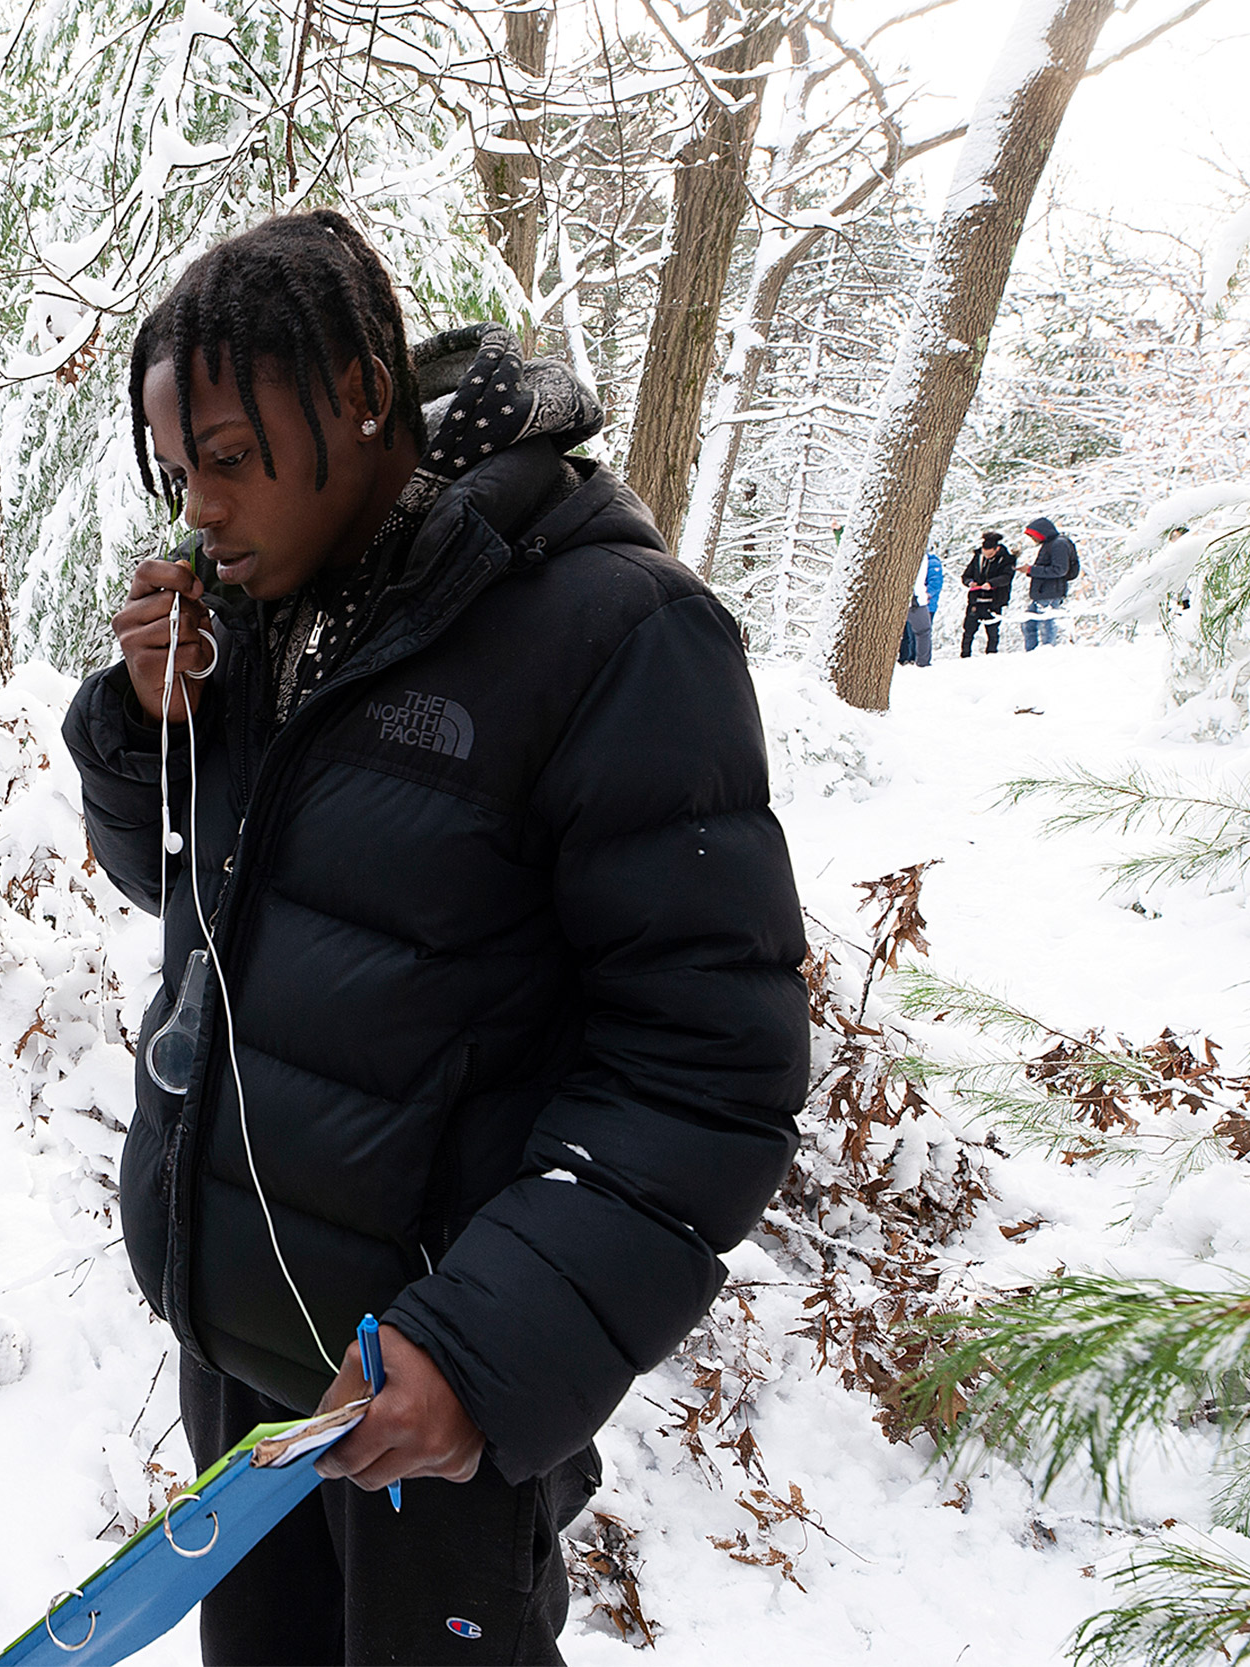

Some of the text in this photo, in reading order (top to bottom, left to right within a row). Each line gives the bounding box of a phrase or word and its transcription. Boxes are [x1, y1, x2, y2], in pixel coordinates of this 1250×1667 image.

[405, 690, 445, 715] THE
[365, 701, 440, 733] NORTH
[379, 722, 434, 749] FACE
